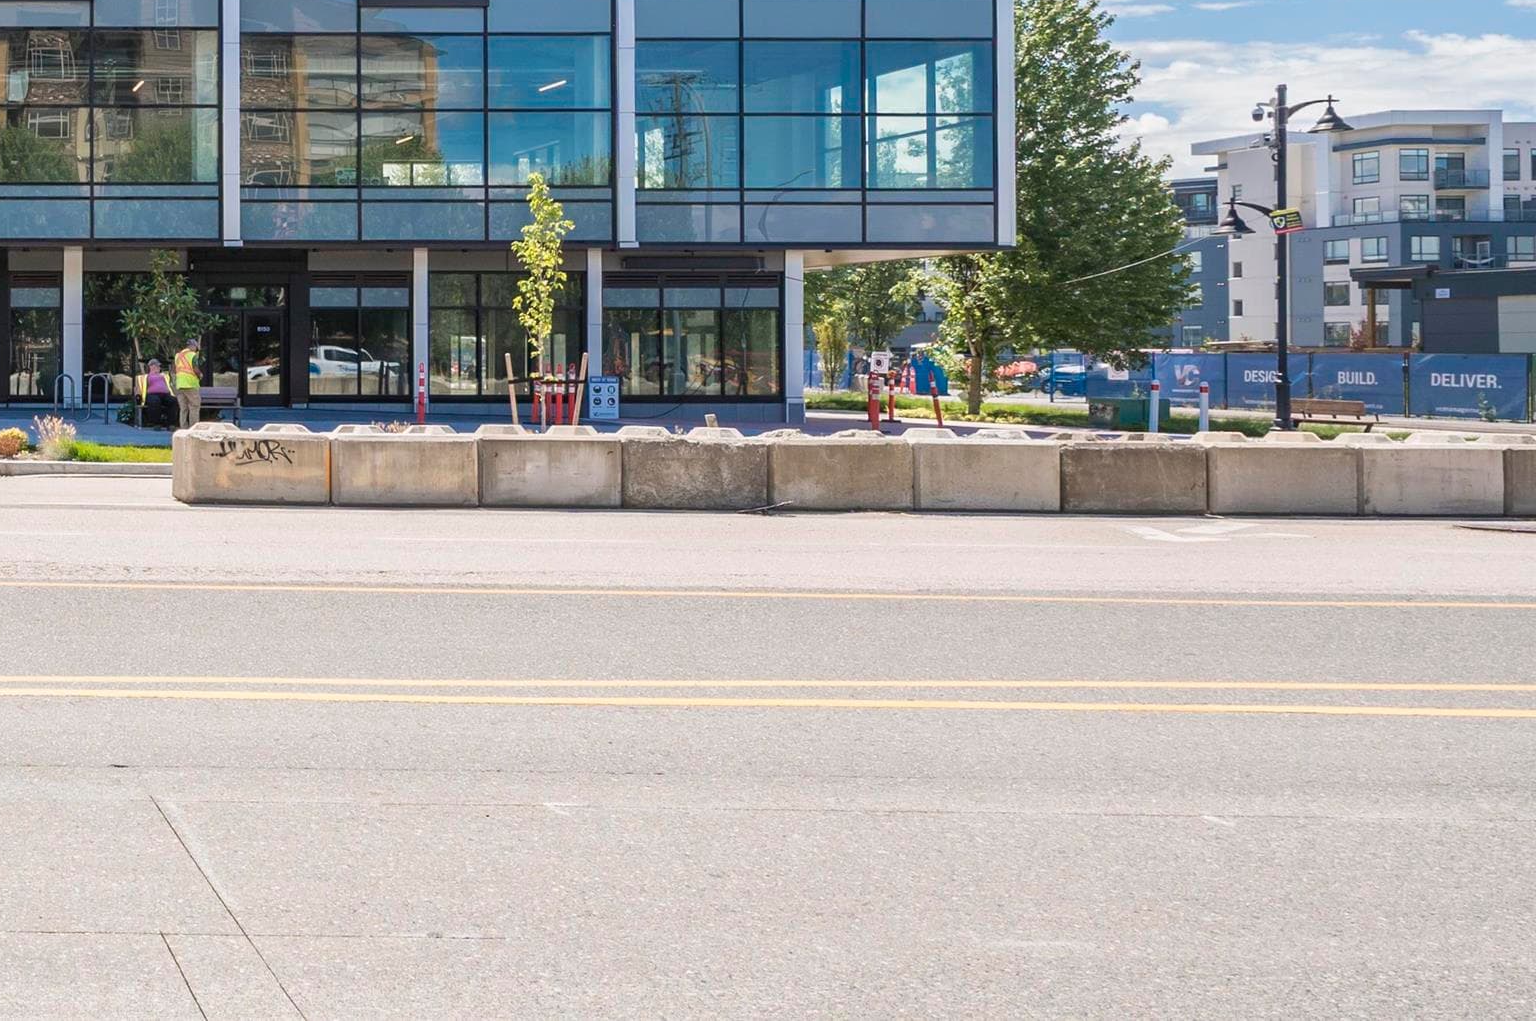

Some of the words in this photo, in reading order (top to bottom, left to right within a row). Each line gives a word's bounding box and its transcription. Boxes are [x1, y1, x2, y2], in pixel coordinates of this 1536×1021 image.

[1244, 369, 1278, 383] DESIG
[1337, 371, 1379, 386] BUILD.
[1430, 373, 1503, 389] DELIVER.
